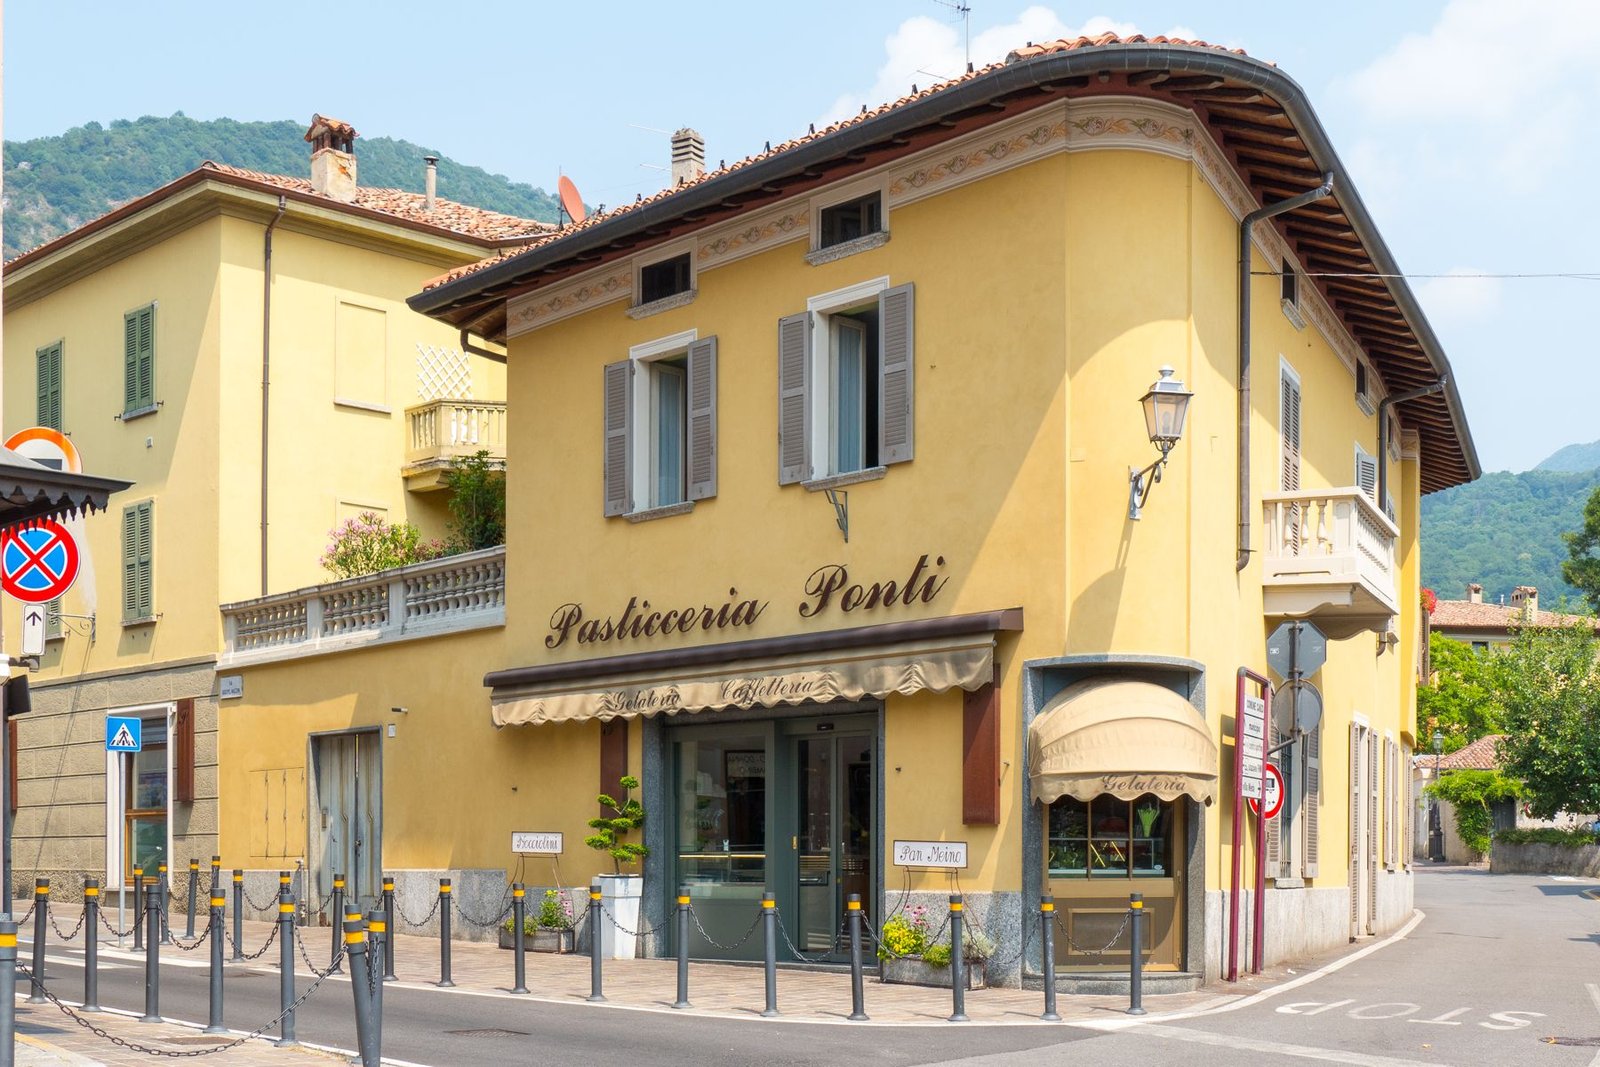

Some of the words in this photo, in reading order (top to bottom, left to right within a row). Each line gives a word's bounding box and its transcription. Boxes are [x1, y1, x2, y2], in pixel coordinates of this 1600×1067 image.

[545, 587, 769, 649] Pasticceria
[798, 554, 950, 618] Ponti
[614, 689, 681, 710] Gelateria
[721, 676, 815, 704] Caffetteria
[1102, 774, 1186, 791] Gelateria
[900, 845, 923, 861] Pan
[927, 846, 961, 863] Meino
[1275, 999, 1548, 1030] STOP
